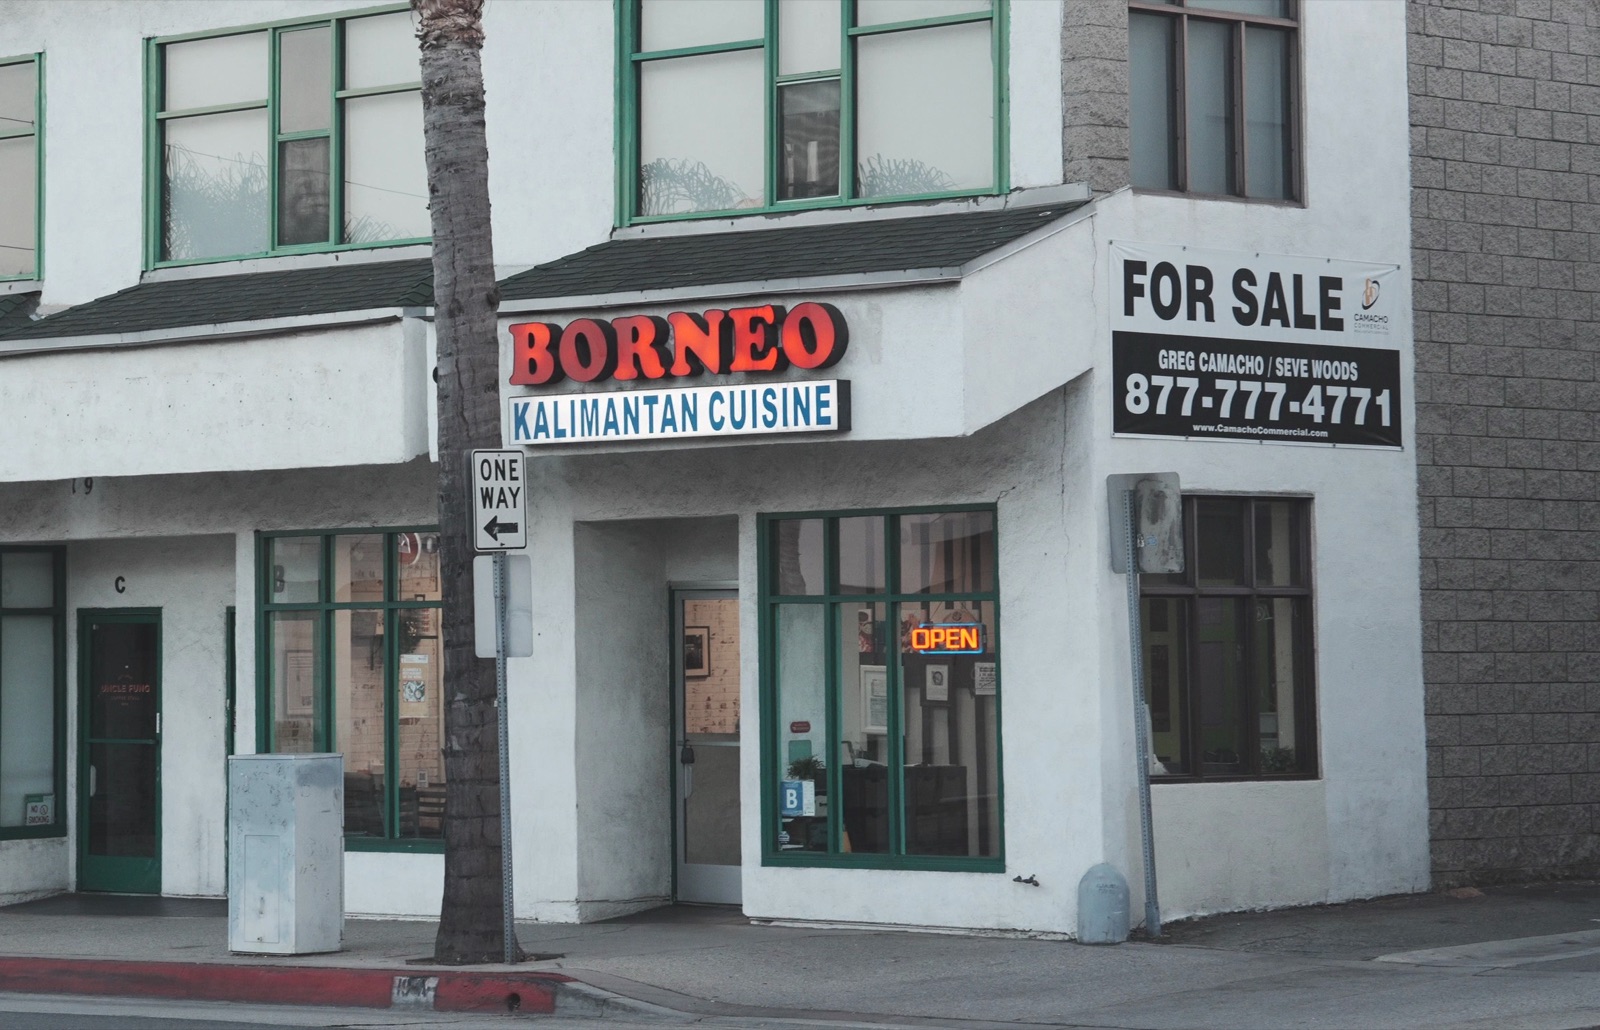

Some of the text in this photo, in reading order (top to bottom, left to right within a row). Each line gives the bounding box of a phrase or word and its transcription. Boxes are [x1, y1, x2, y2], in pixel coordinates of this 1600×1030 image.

[1123, 259, 1345, 332] FOR SALE
[1354, 313, 1389, 324] CAMACHO
[1354, 322, 1389, 331] COMMERCIAL
[509, 302, 847, 386] BORNEO
[1158, 349, 1358, 381] GREG CAMACHO / SEVE WOODS
[1125, 373, 1391, 427] 877-777-4771
[513, 385, 832, 441] KALIMANTAN CUISINE
[1193, 423, 1328, 438] www.CamachoCommercial.com
[480, 458, 519, 481] ONE
[480, 486, 521, 510] WAY
[115, 576, 126, 594] C
[911, 628, 979, 650] OPEN
[101, 684, 150, 693] UNCLE FUNG
[31, 805, 38, 813] NO
[786, 789, 798, 809] B
[28, 816, 49, 824] SMOKING
